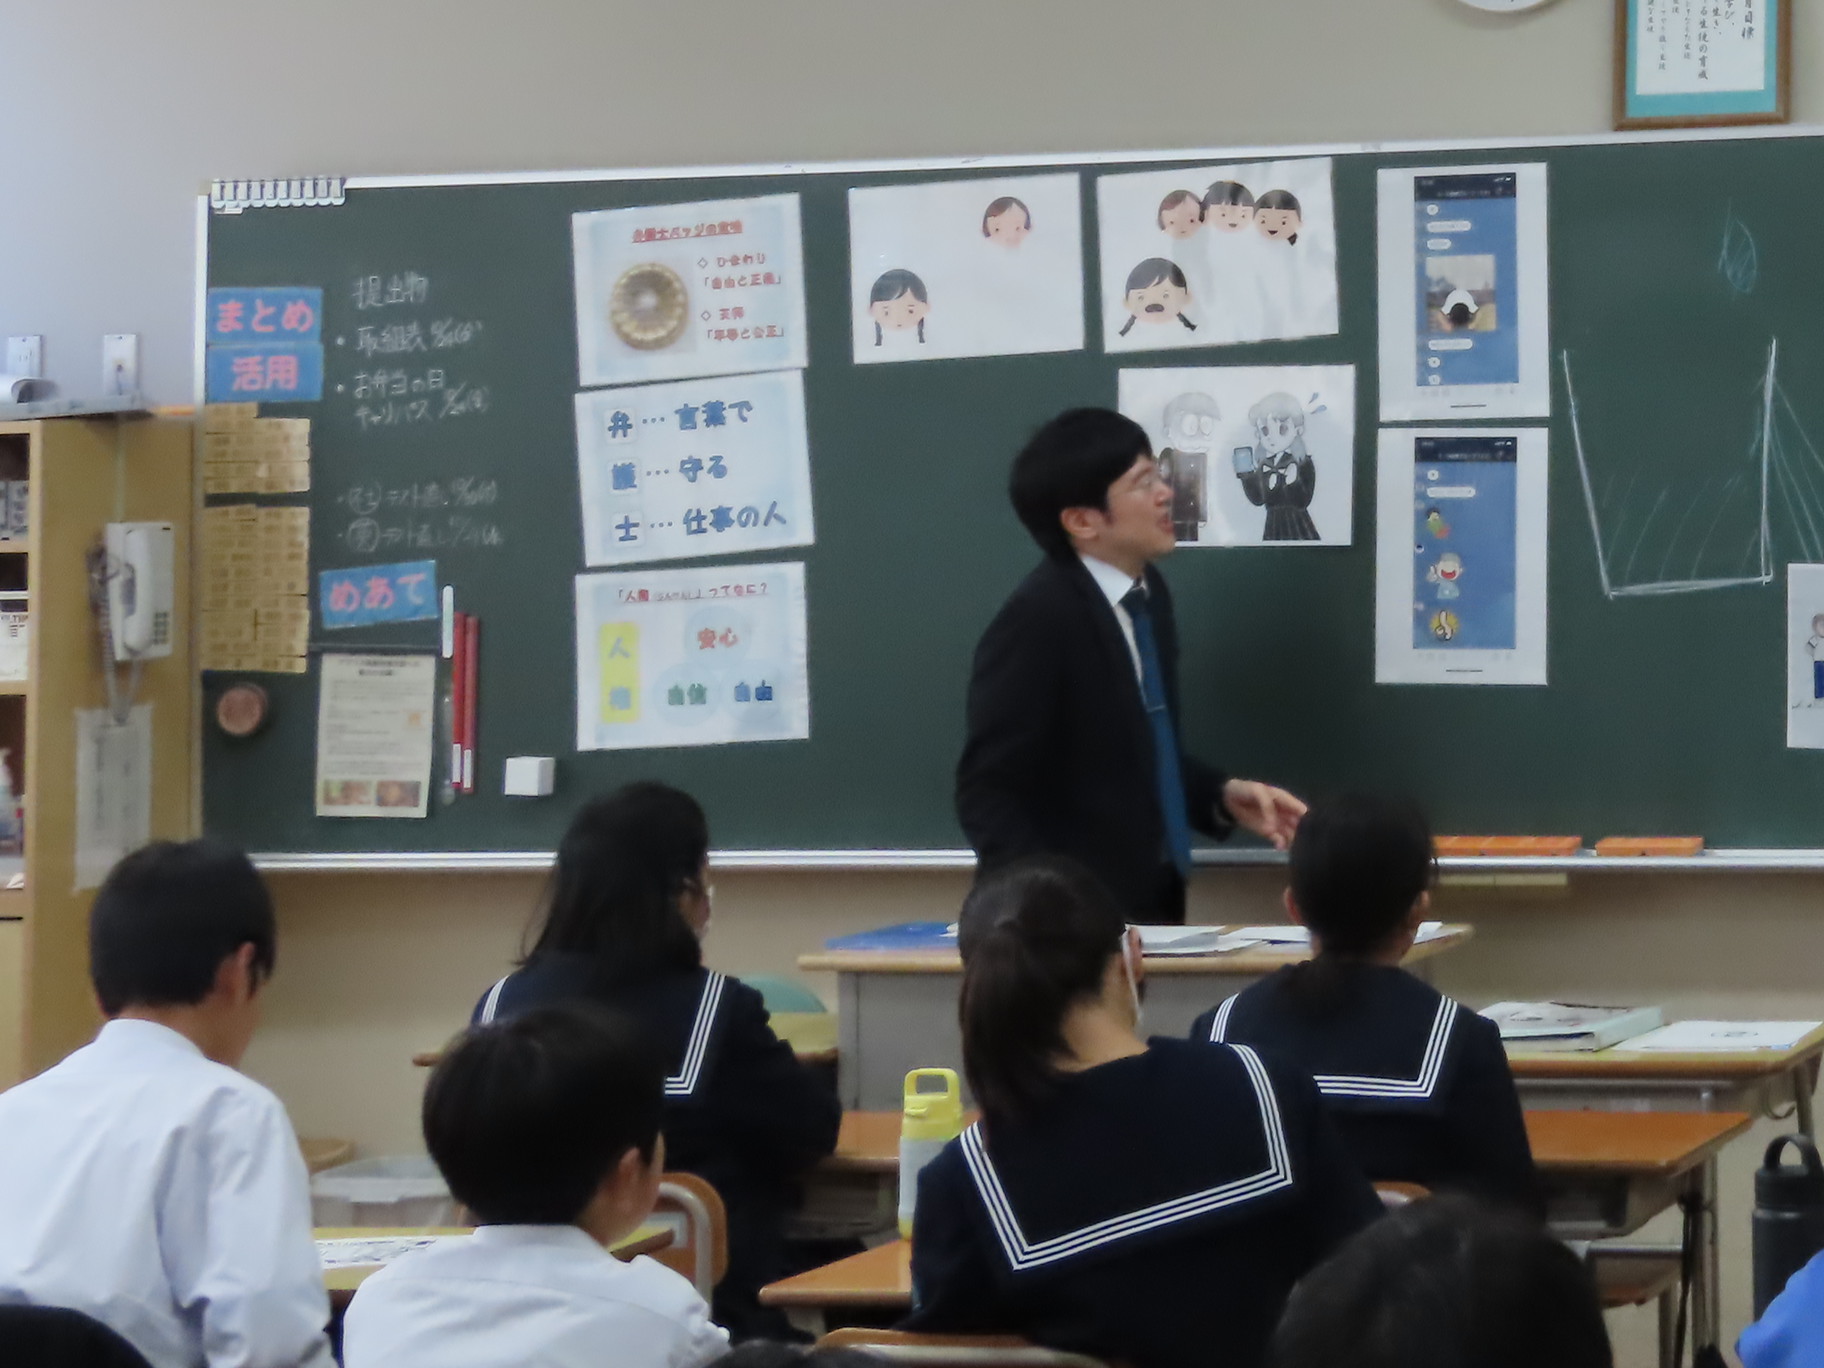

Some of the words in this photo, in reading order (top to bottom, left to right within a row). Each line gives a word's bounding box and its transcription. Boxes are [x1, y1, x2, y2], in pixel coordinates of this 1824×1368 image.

[717, 253, 766, 268] ひまわり
[216, 300, 314, 333] まとめ
[232, 355, 297, 391] 活用
[329, 572, 427, 612] めあて
